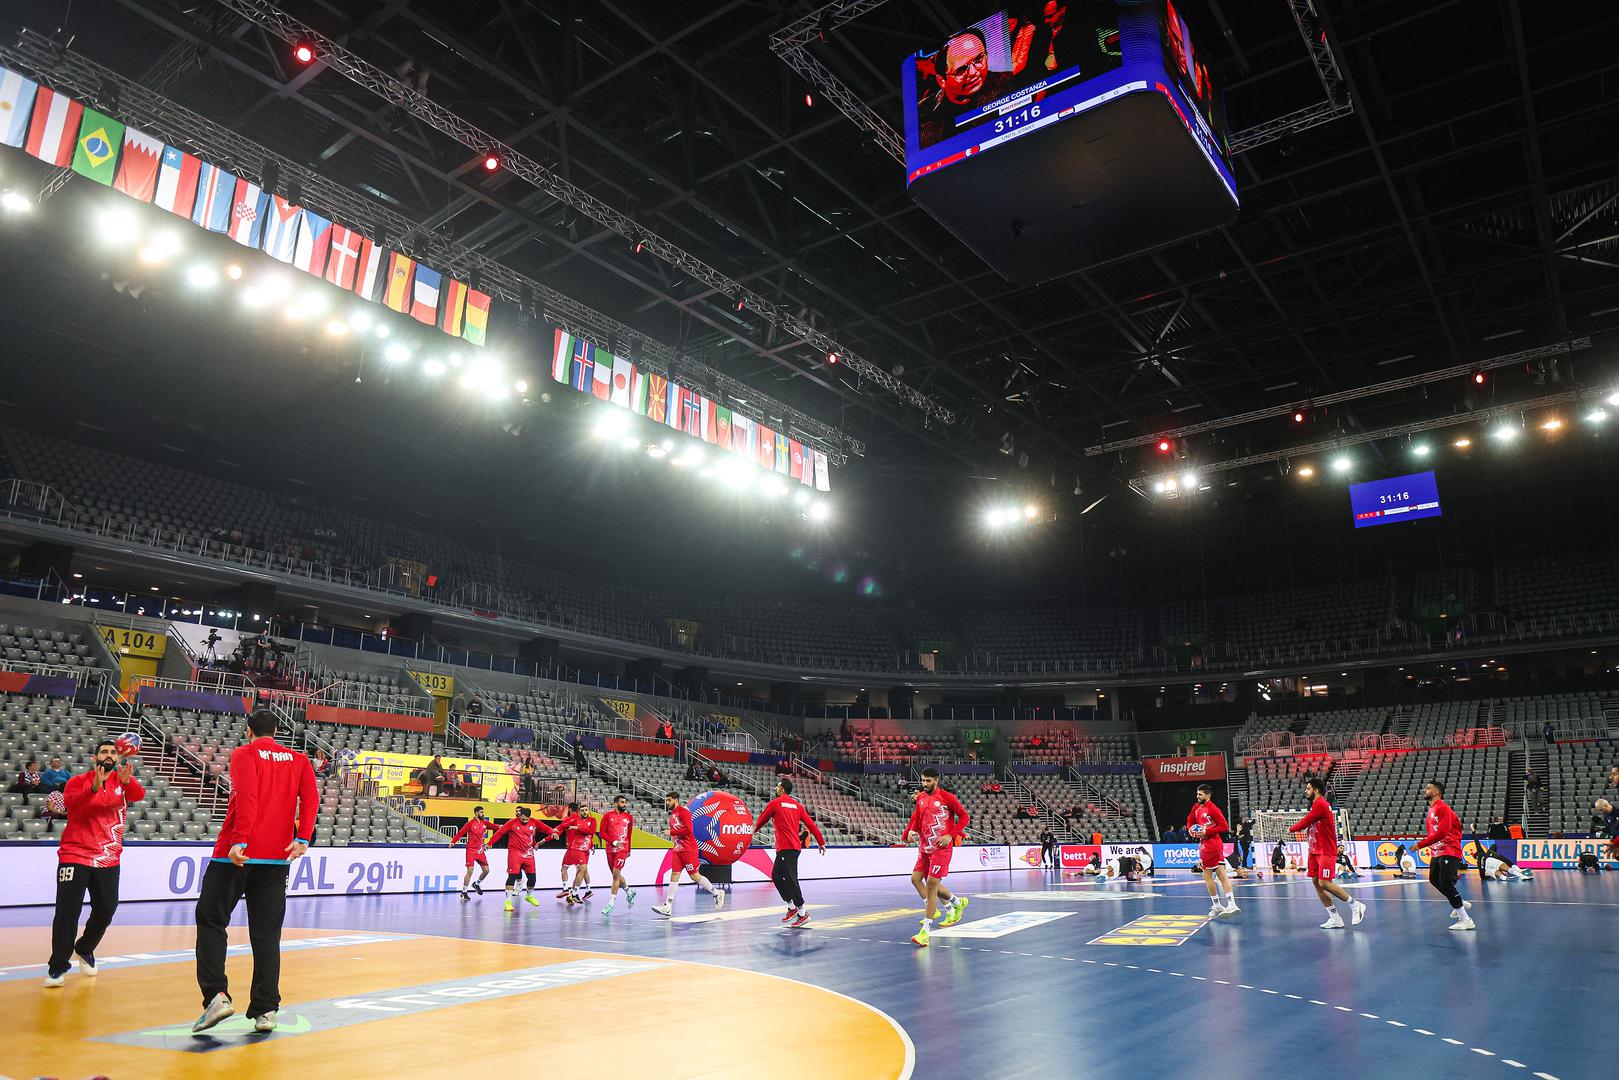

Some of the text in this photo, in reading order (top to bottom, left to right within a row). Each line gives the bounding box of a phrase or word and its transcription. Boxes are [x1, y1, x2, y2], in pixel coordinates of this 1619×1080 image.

[982, 81, 1048, 112] GEORGE COSTANZA
[994, 105, 1041, 133] 31:16
[1380, 491, 1409, 504] 31:16
[121, 631, 155, 650] 104
[425, 675, 447, 690] 103
[1160, 760, 1206, 775] inspired
[1110, 845, 1140, 855] We are
[617, 858, 625, 867] 77
[931, 865, 941, 874] 17
[60, 866, 75, 882] 99
[346, 860, 404, 893] 29th
[1322, 868, 1331, 878] 10
[333, 960, 655, 1012] freenet
